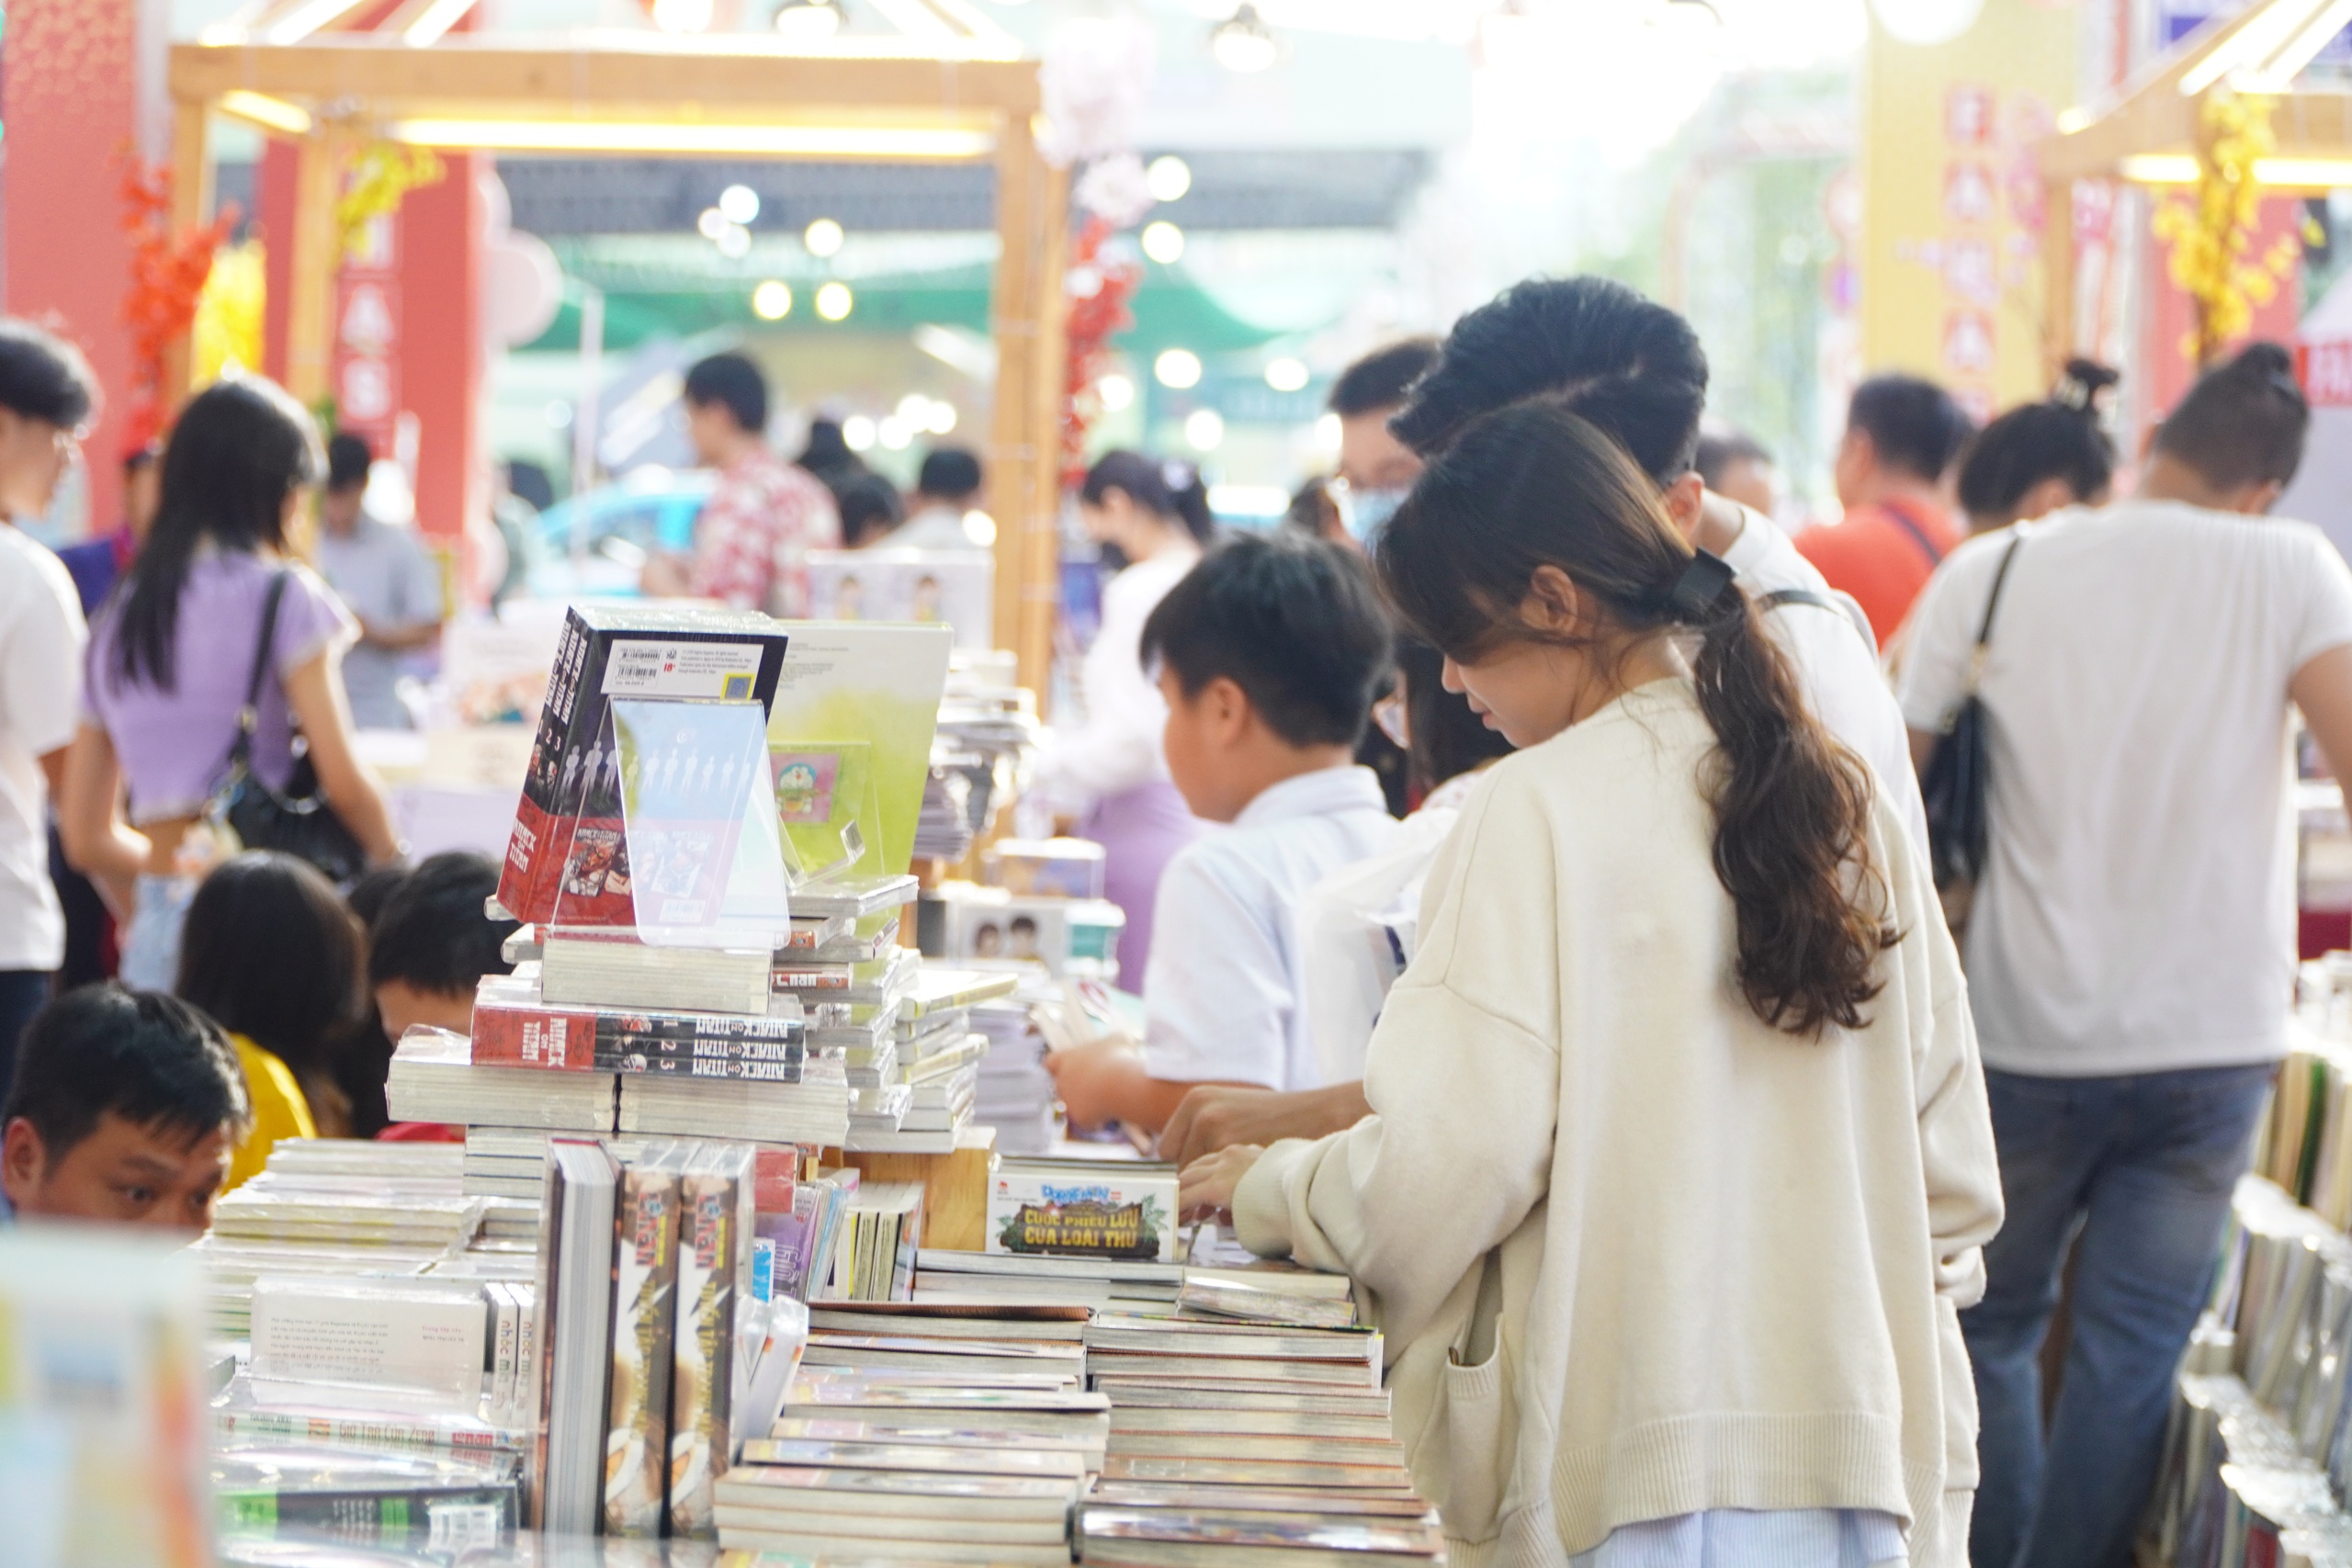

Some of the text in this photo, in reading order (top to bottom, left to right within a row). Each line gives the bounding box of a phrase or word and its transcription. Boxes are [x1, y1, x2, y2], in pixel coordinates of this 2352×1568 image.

[563, 628, 580, 674] ATTACK
[571, 636, 587, 682] ATTACK
[552, 681, 567, 717] TITAN
[560, 689, 575, 726] TITAN
[546, 728, 552, 745] 2
[554, 736, 561, 751] 3
[512, 817, 537, 853] ATTACK
[509, 842, 529, 874] TITAN
[663, 1019, 678, 1028] 1
[695, 1018, 788, 1038] ATTACK ON TITAN
[522, 1021, 540, 1062] TITAN
[540, 1033, 548, 1049] ON
[548, 1017, 567, 1068] ATTACK
[661, 1039, 676, 1052] 2
[693, 1039, 786, 1061] ATTACK ON TITAN
[660, 1059, 675, 1070] 3
[692, 1058, 785, 1080] ATTACK ON TITAN
